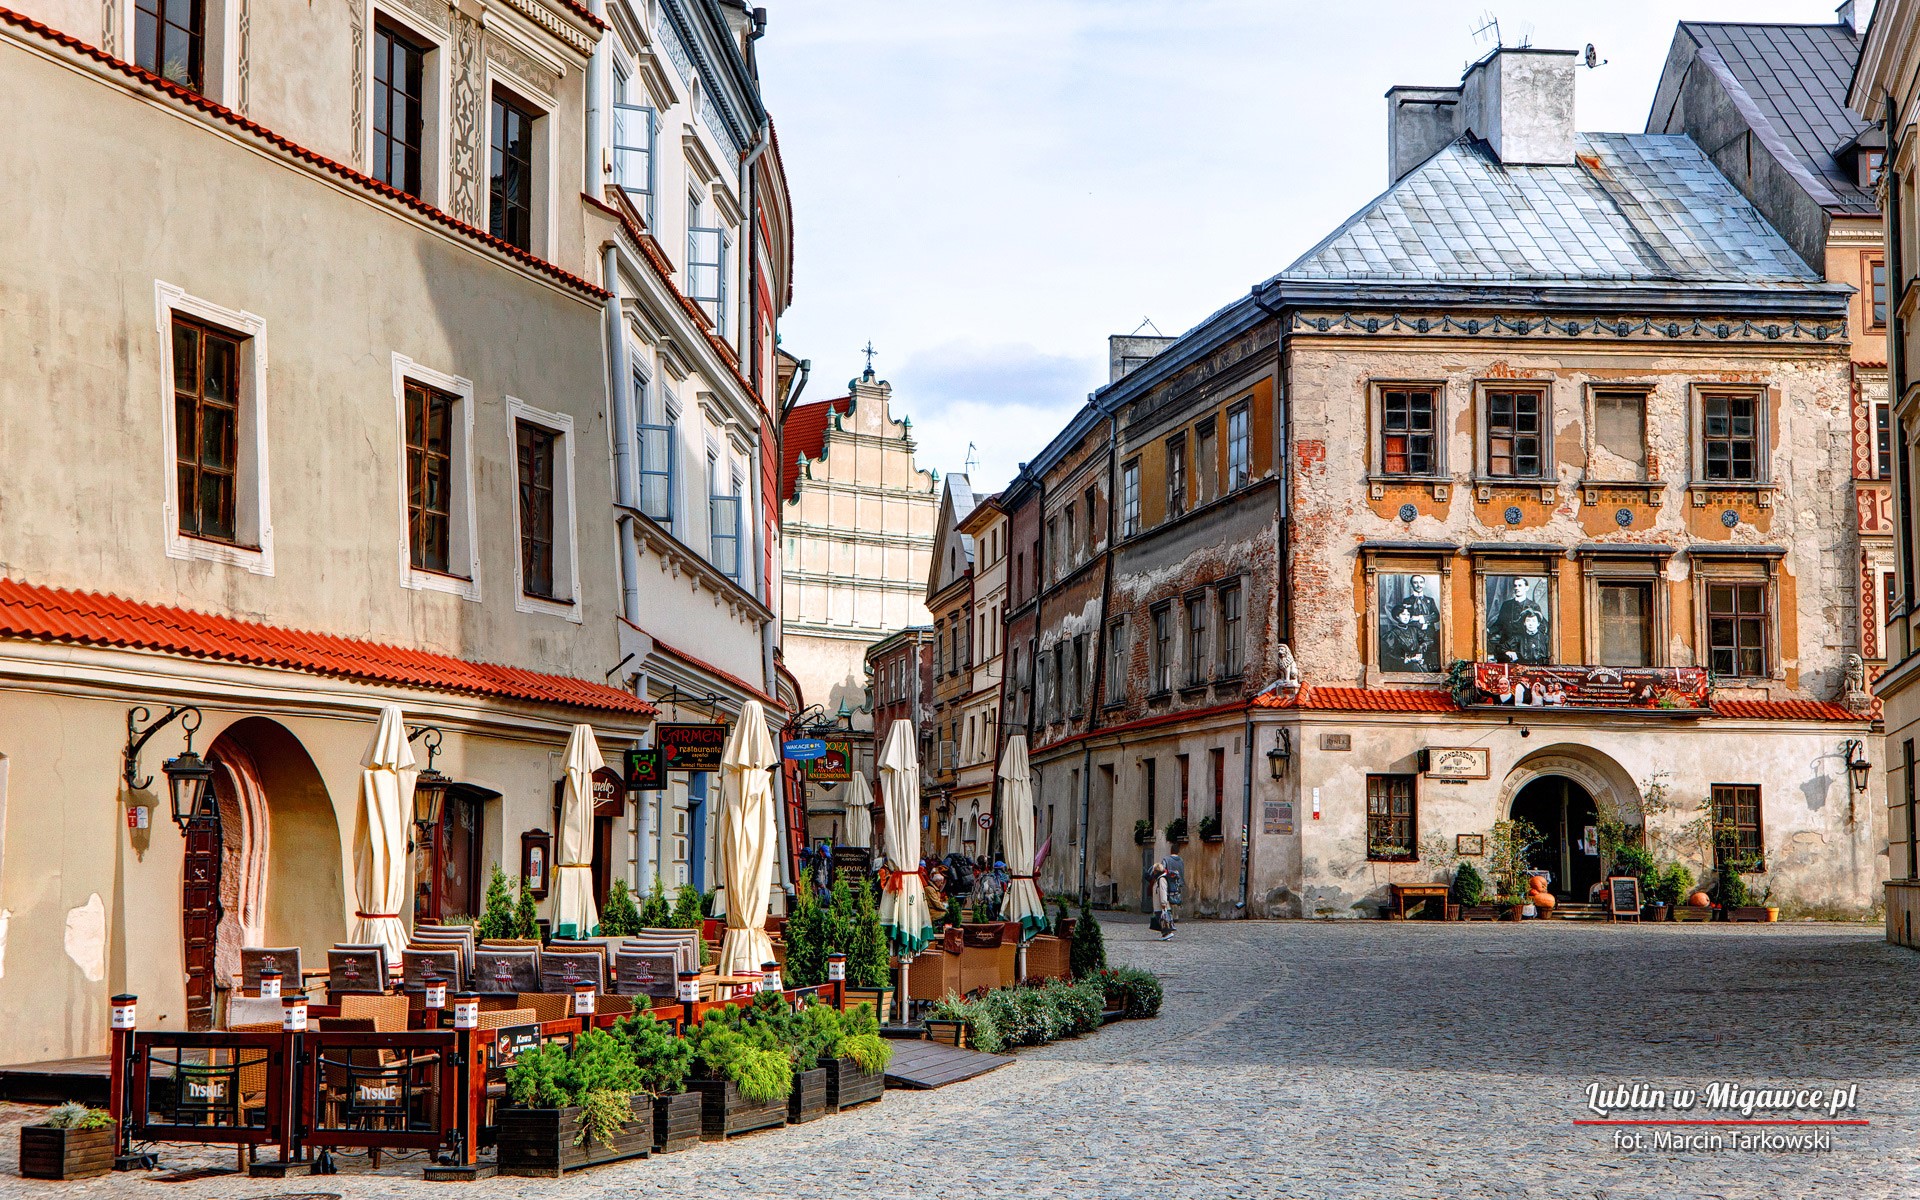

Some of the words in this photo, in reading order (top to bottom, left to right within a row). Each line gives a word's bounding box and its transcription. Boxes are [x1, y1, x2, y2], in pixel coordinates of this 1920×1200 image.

[660, 728, 722, 743] CARMEN
[680, 745, 721, 753] restaurante
[188, 1082, 224, 1098] TYSKIE
[360, 1084, 396, 1100] TYSKIE
